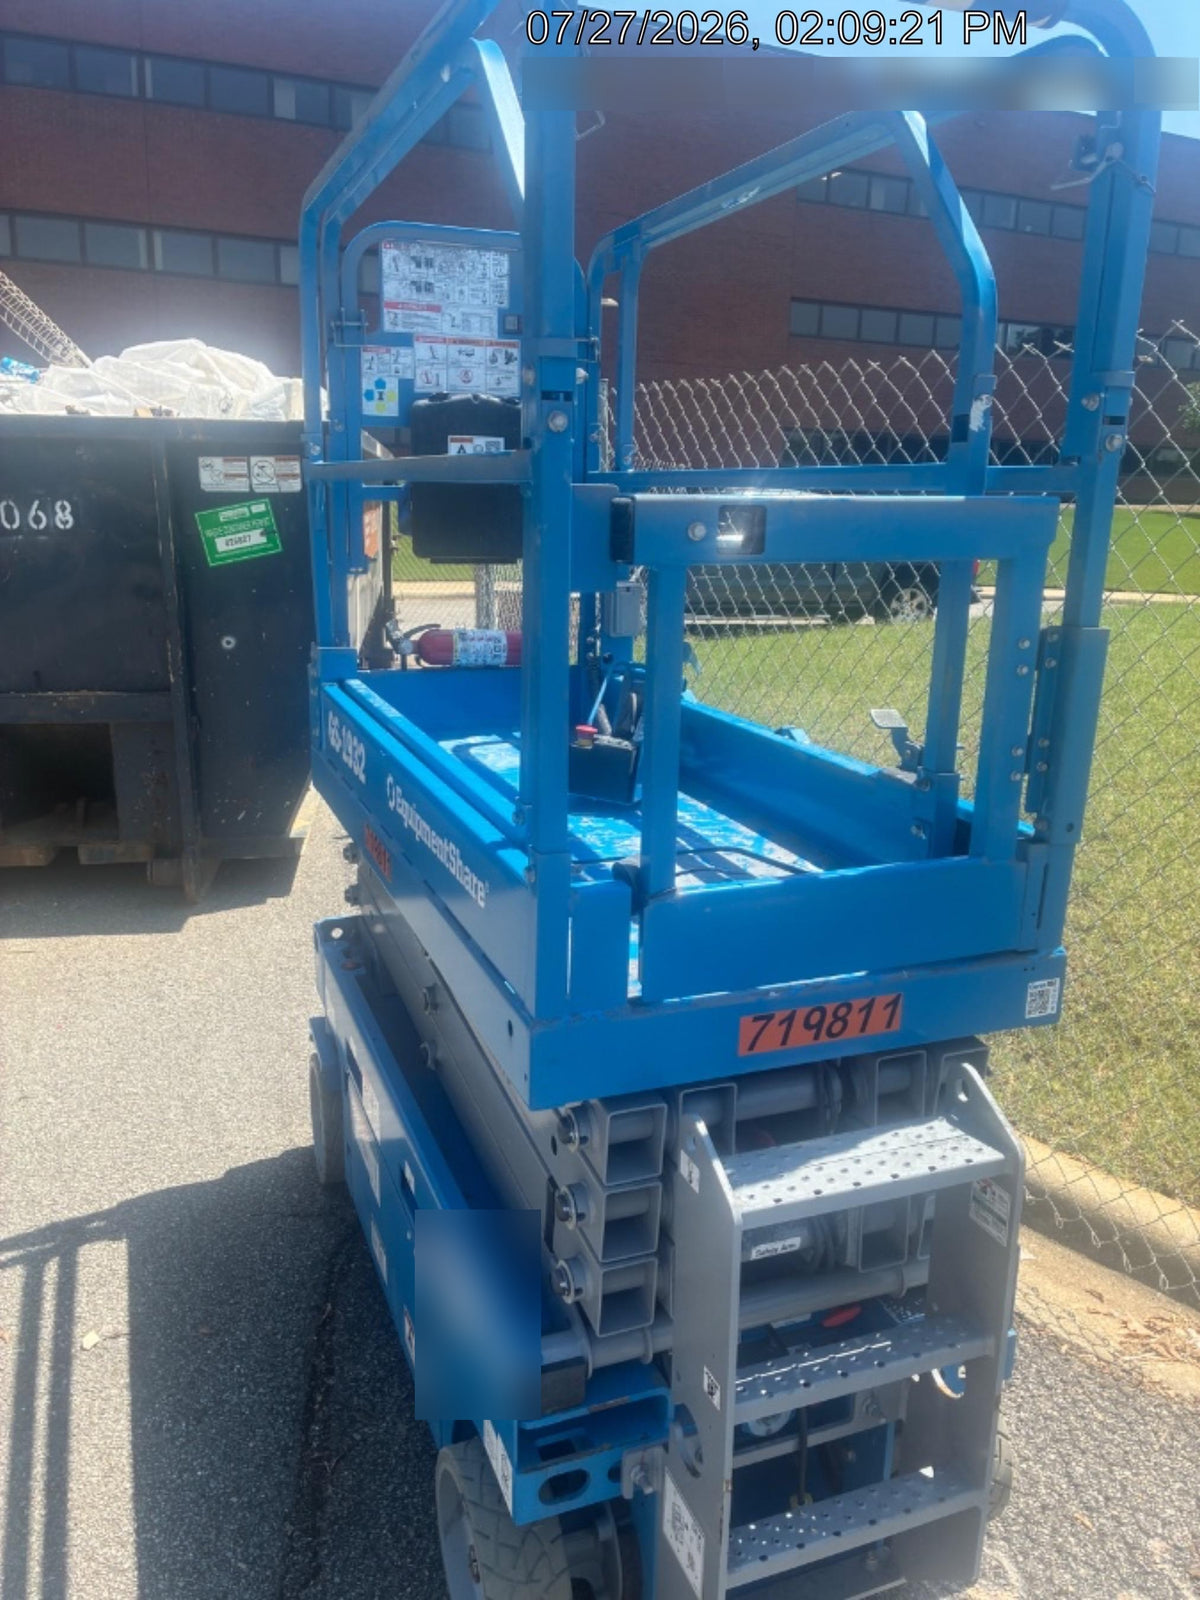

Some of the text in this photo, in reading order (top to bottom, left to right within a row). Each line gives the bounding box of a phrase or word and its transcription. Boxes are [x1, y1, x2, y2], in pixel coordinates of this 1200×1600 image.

[0, 499, 74, 530] 068
[396, 785, 486, 908] EquipmentShare
[747, 993, 902, 1052] 719811
